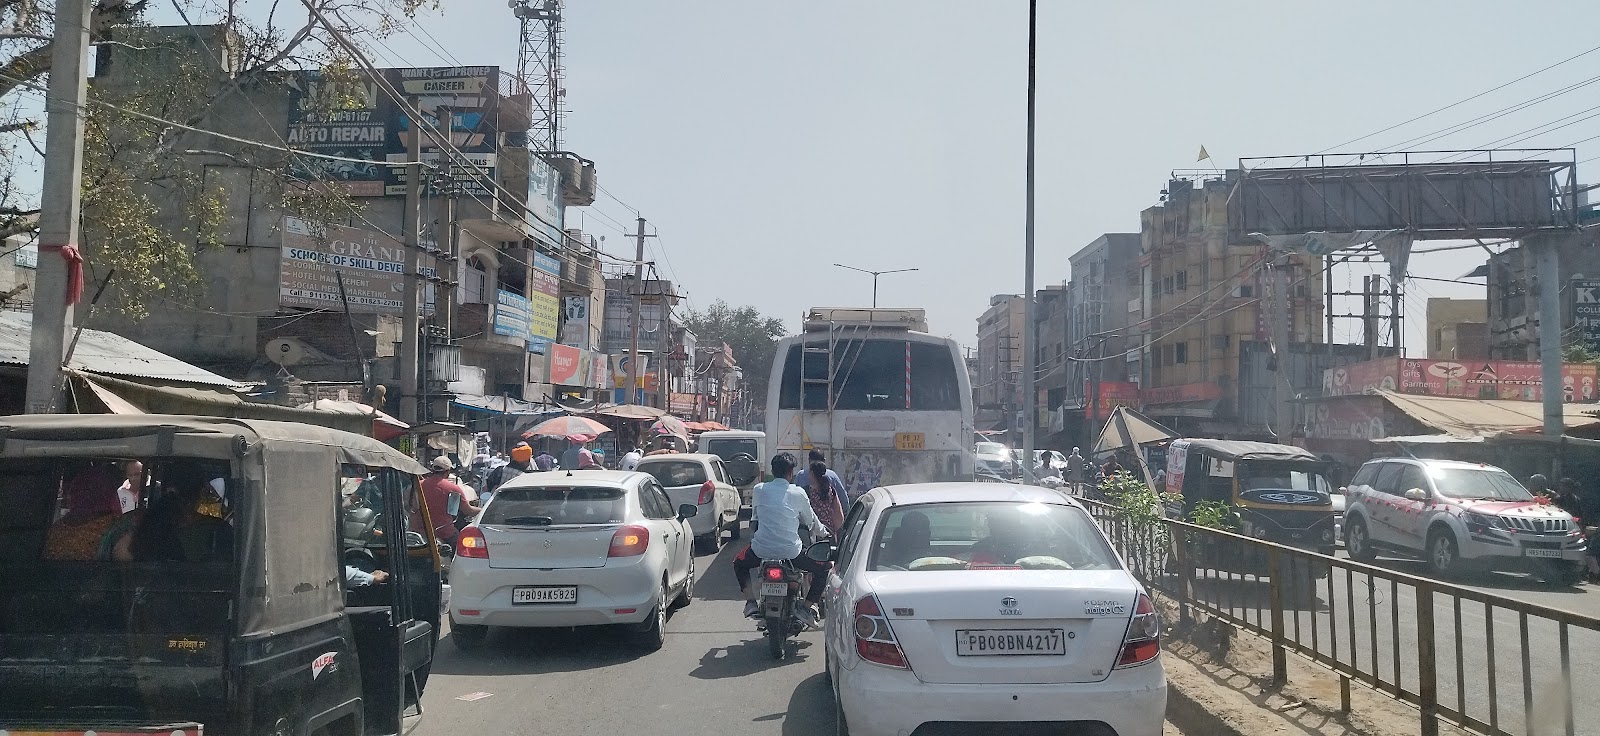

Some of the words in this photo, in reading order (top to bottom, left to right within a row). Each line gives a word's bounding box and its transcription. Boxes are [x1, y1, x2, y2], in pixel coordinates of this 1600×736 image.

[401, 69, 428, 78] WANT
[424, 81, 465, 91] CAREER
[288, 127, 328, 143] AUTO
[331, 126, 385, 142] REPAIR
[363, 238, 380, 246] THE
[331, 240, 405, 262] GRAND
[292, 261, 326, 272] COOKING
[333, 255, 347, 266] OF
[349, 258, 375, 270] SKILL
[292, 271, 318, 281] HOTEL
[289, 289, 303, 297] Call
[292, 281, 319, 292] SOCIAL
[320, 284, 342, 293] MEDI
[346, 287, 387, 299] MARKETING
[1403, 361, 1421, 370] Toys
[1402, 369, 1421, 378] Gifts
[1402, 379, 1441, 388] Garments
[520, 589, 575, 600] PB09AK5829
[969, 634, 1059, 651] PB08BN4217
[313, 656, 335, 669] ALFA
